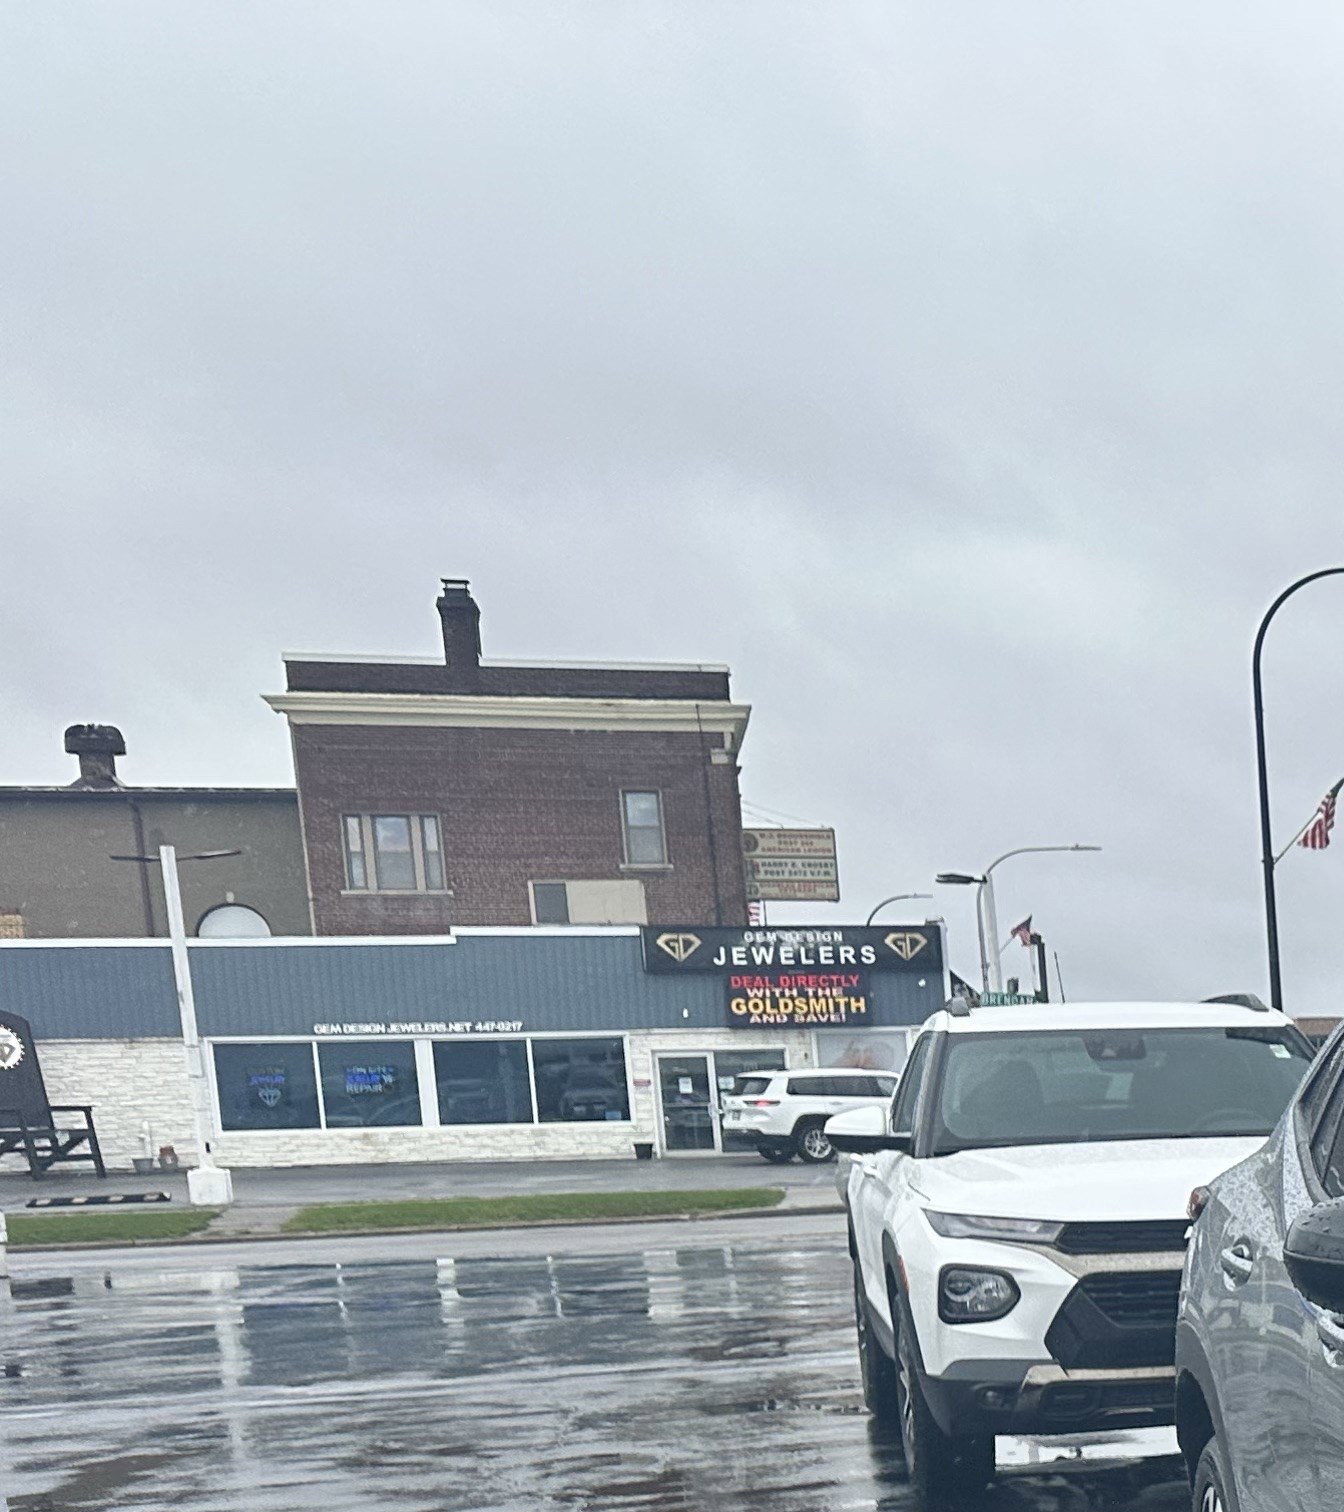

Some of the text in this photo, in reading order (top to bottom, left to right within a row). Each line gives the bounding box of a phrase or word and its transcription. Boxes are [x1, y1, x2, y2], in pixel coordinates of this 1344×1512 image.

[744, 929, 843, 943] GEM DESIGN
[713, 945, 877, 966] JEWELERS
[730, 974, 860, 989] DEAL DIRECTLY
[746, 986, 844, 998] WITH THE
[730, 996, 867, 1016] GOLDSMITH
[749, 1013, 788, 1024] AND
[313, 1022, 342, 1035] GEM
[342, 1022, 386, 1034] DESIGN
